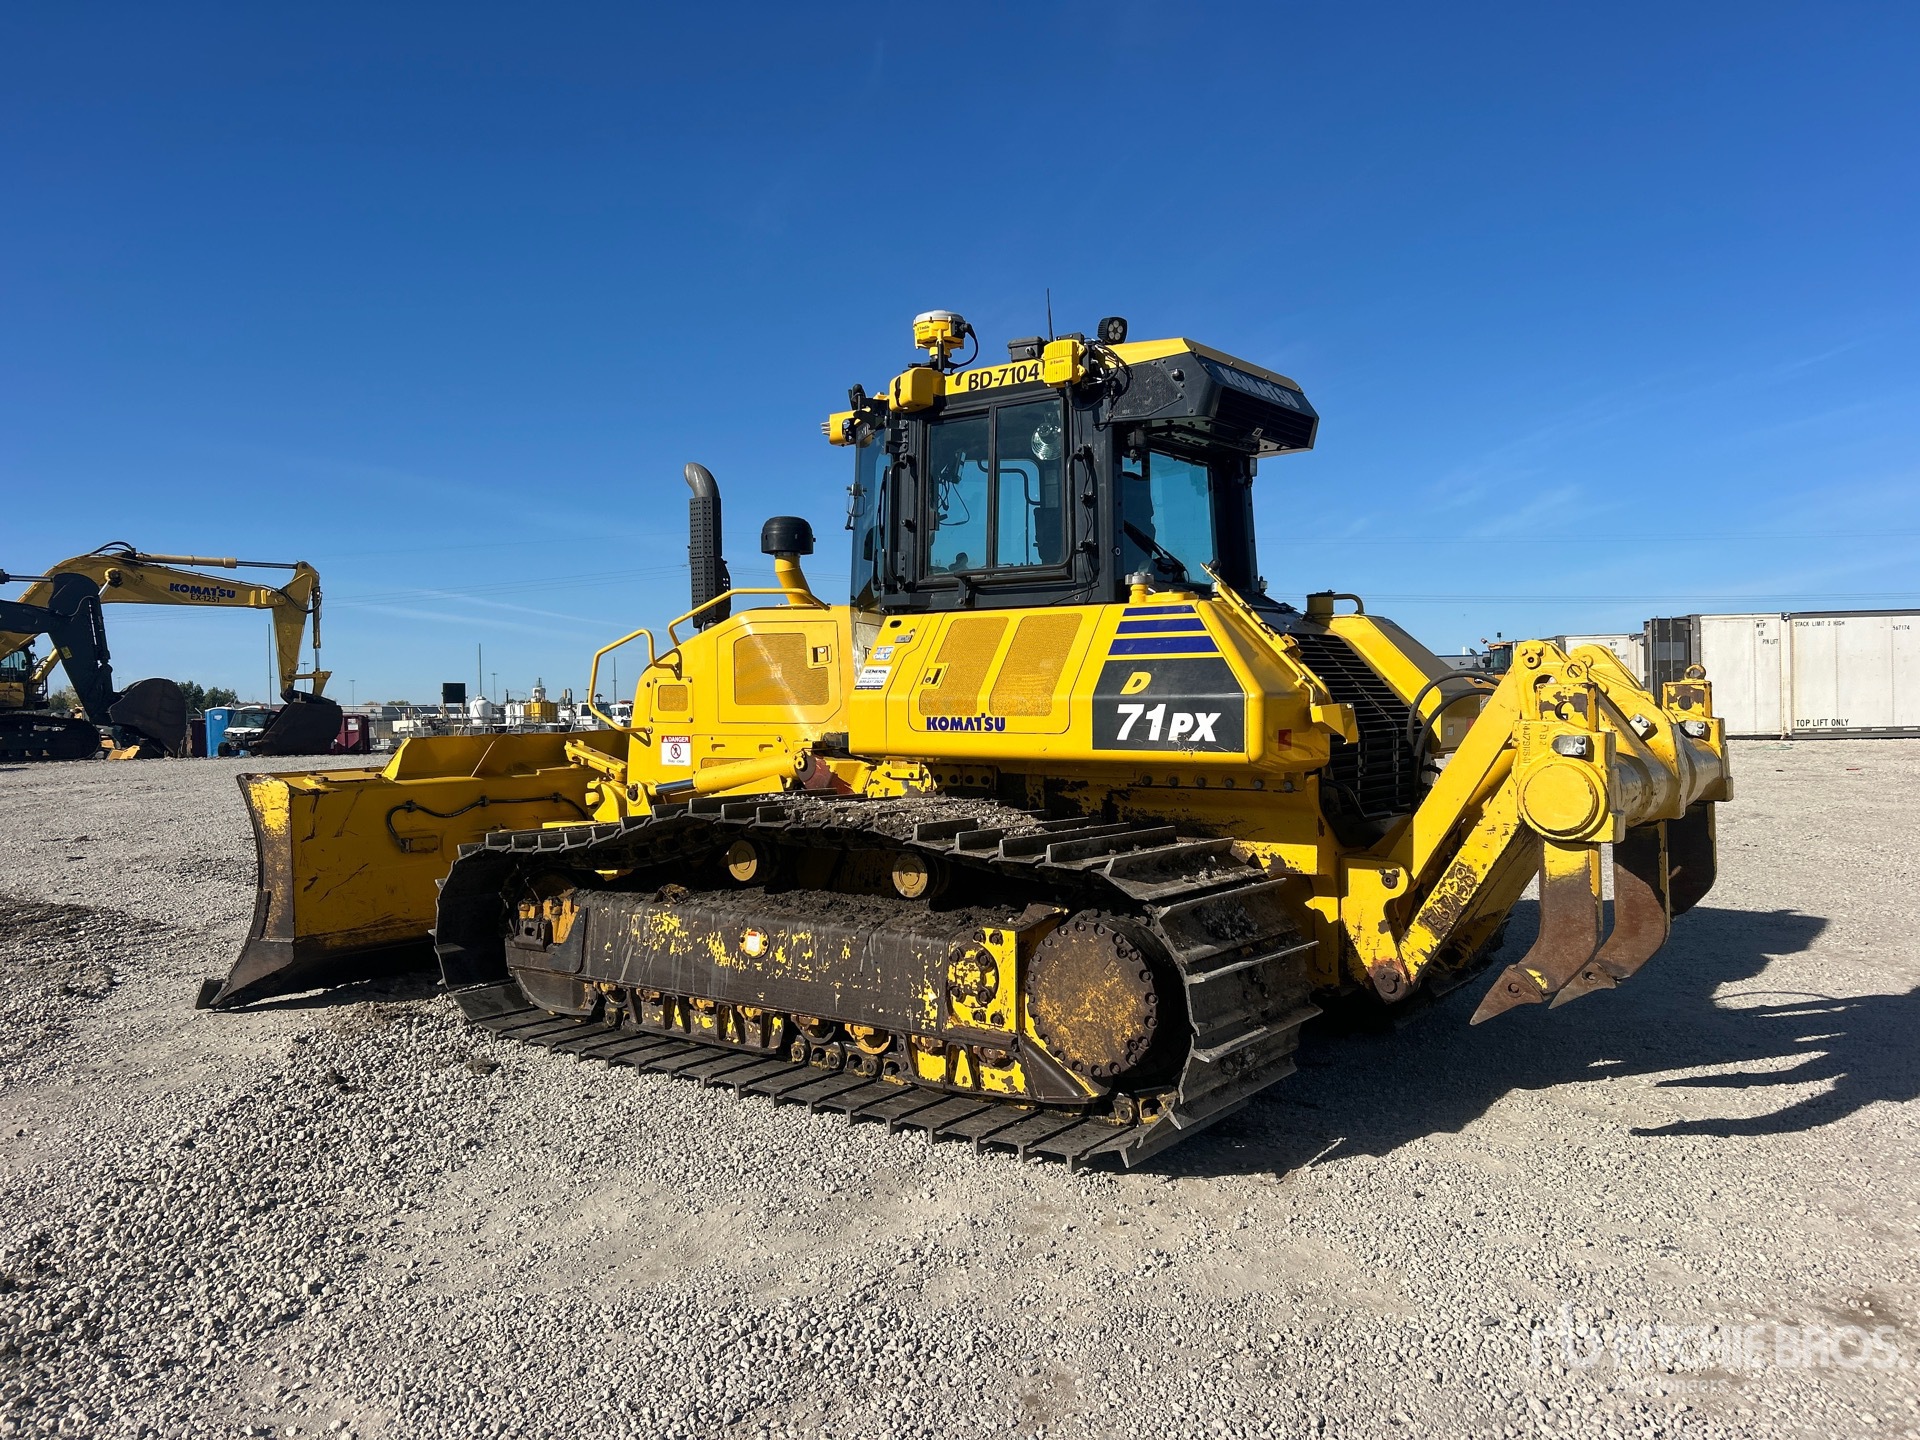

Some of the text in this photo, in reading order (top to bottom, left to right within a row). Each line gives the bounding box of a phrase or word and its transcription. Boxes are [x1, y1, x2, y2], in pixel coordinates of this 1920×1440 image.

[968, 363, 1040, 391] BD-7104
[1216, 365, 1300, 409] KOMATSU
[169, 583, 236, 599] KOMATSU
[1120, 671, 1152, 695] D
[926, 712, 1006, 732] KOMATSU
[1796, 719, 1849, 727] TOP LIFT ONLY
